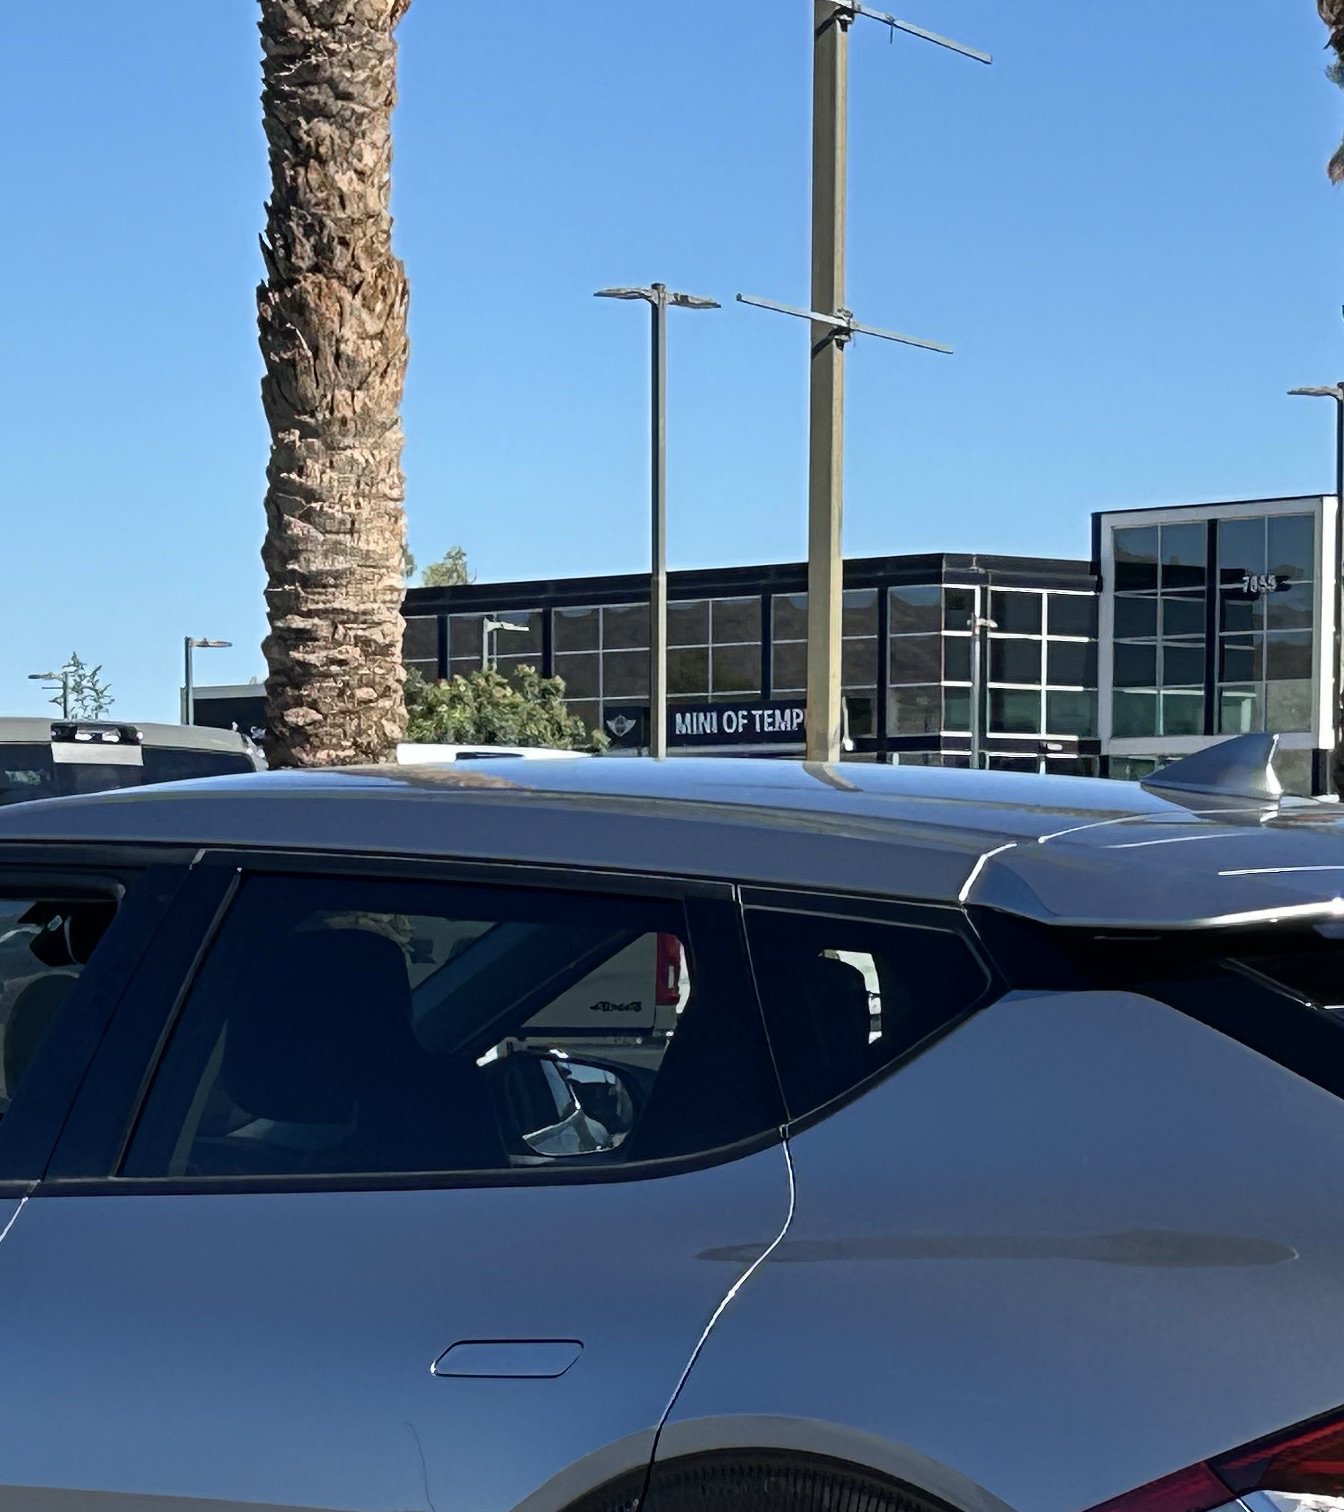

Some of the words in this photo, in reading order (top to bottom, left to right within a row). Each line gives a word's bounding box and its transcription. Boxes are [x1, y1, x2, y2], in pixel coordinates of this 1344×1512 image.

[675, 711, 718, 735] MINI
[722, 709, 748, 733] OF
[750, 708, 807, 732] TEMP
